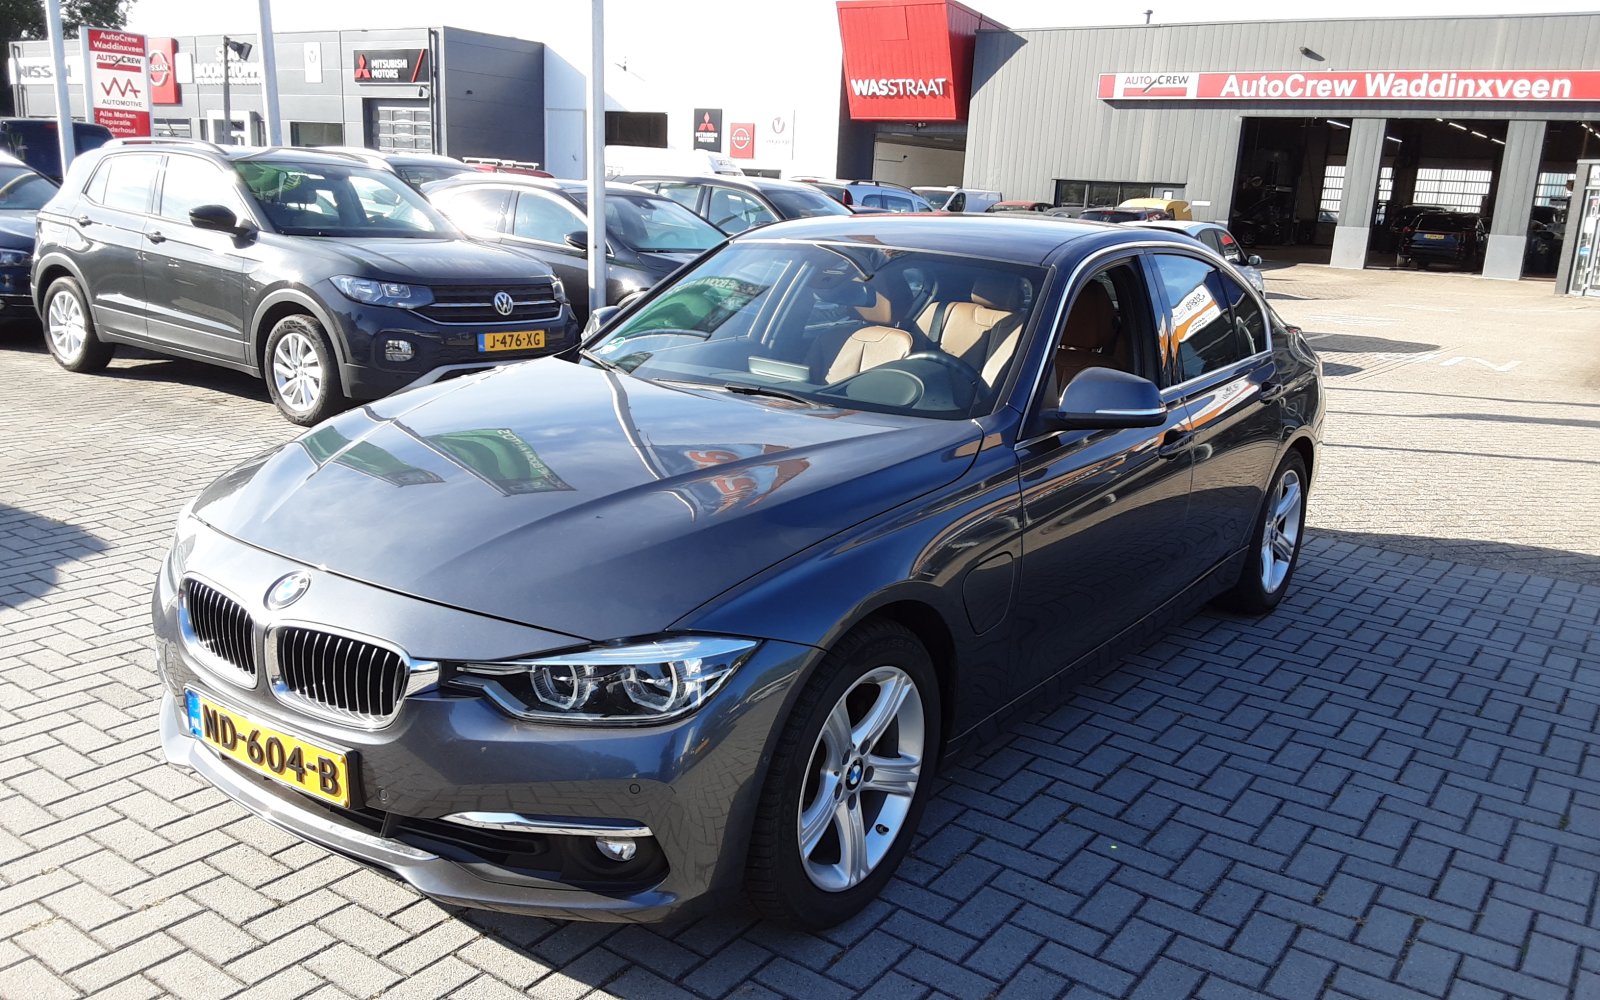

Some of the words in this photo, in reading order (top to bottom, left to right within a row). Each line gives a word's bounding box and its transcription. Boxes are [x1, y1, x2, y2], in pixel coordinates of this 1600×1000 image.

[100, 32, 138, 42] AutoCrew
[93, 40, 144, 53] Waddinxveen
[371, 59, 408, 68] MITSUBISHI
[371, 69, 399, 78] MOTORS
[851, 78, 946, 96] WASSTRAAT
[1220, 74, 1357, 98] AutoCrew
[1365, 73, 1572, 98] Waddinxveen
[102, 99, 142, 107] AUTOMOTIVE
[100, 118, 130, 126] Reparatie
[490, 333, 540, 348] J-476-XG
[202, 703, 341, 796] ND-604-B
